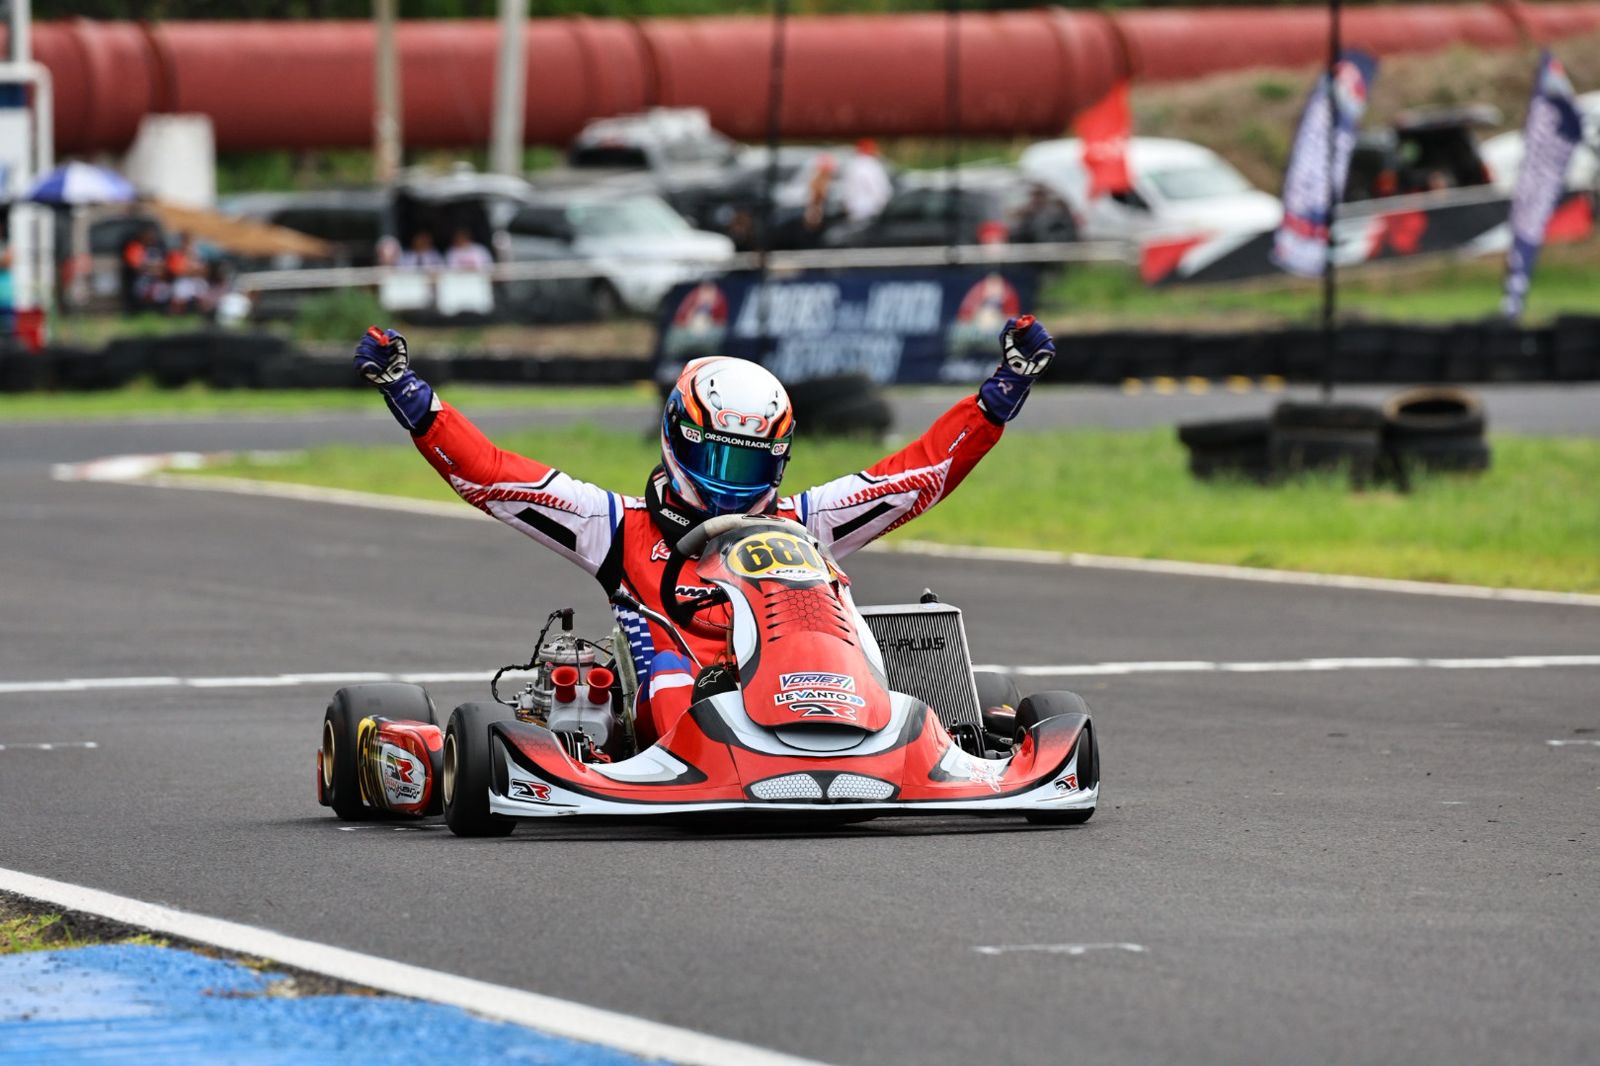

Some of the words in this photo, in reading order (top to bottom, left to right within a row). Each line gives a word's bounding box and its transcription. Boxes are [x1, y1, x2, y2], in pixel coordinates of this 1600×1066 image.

[704, 432, 745, 446] ORSOLON
[744, 440, 771, 450] RACING
[659, 508, 691, 527] sparco
[782, 673, 849, 688] VORTEX
[776, 691, 848, 703] LEVANTO
